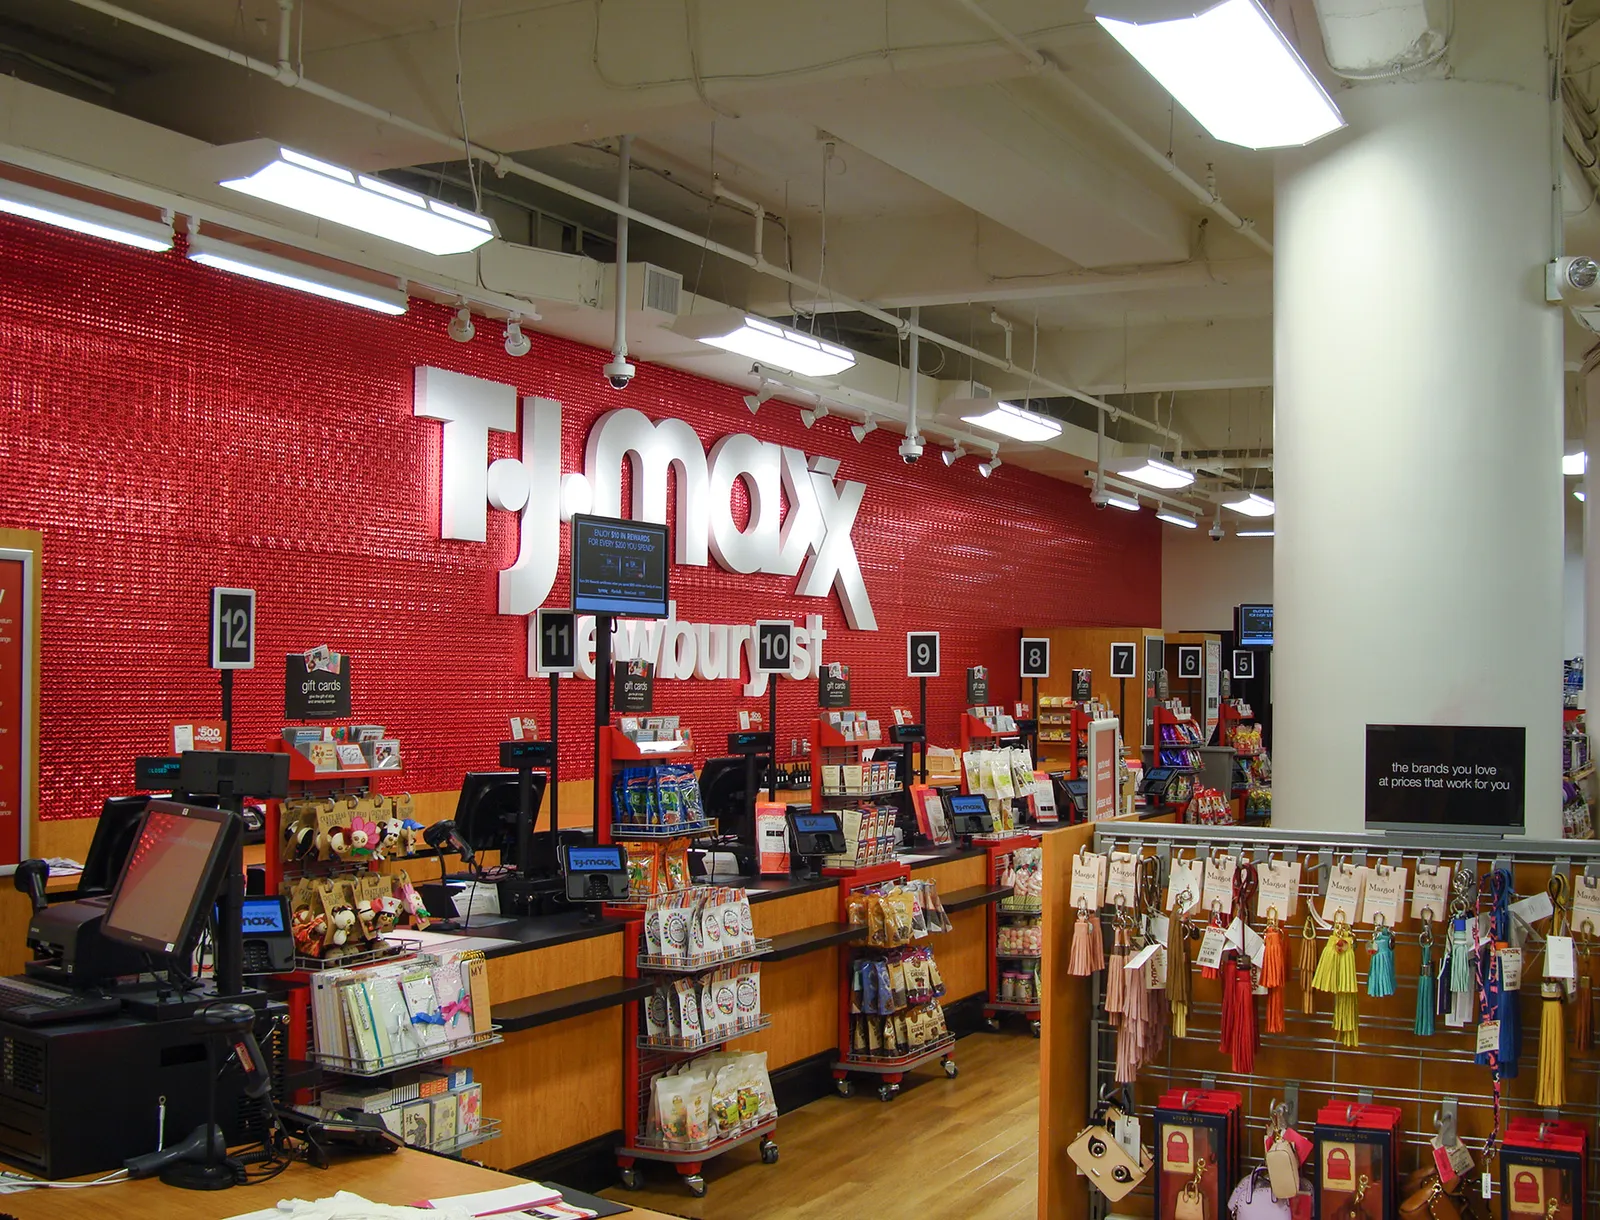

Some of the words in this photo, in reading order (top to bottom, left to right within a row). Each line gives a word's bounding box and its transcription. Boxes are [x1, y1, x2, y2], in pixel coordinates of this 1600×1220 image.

[627, 532, 650, 542] REWARDS
[600, 540, 615, 548] EVERY
[221, 608, 248, 649] 12
[545, 624, 569, 656] 11
[761, 633, 788, 660] 10
[527, 599, 770, 697] ewbury
[789, 614, 827, 681] st
[916, 644, 931, 666] 9
[1029, 648, 1041, 668] 8
[1118, 651, 1130, 669] 7
[1186, 655, 1196, 671] 6
[1239, 657, 1248, 672] 5
[302, 680, 316, 694] gift
[318, 680, 341, 691] cards
[624, 681, 634, 692] gift
[634, 682, 648, 691] cards
[1392, 762, 1409, 773] the
[1412, 762, 1450, 774] brands
[1452, 766, 1472, 776] you
[1475, 764, 1497, 776] love
[1378, 778, 1388, 787] at
[1391, 777, 1422, 789] prices
[1424, 778, 1444, 788] that
[1446, 778, 1472, 789] work
[1474, 778, 1488, 790] for
[1490, 781, 1510, 792] you
[1074, 869, 1096, 879] Margot
[1112, 866, 1136, 878] Margot
[1207, 872, 1231, 883] Margot
[1262, 878, 1287, 889] Margot
[1331, 881, 1357, 893] Margot
[1369, 883, 1395, 894] Margot
[1417, 880, 1443, 891] Margot
[1577, 890, 1600, 903] Margo
[471, 966, 483, 977] MY
